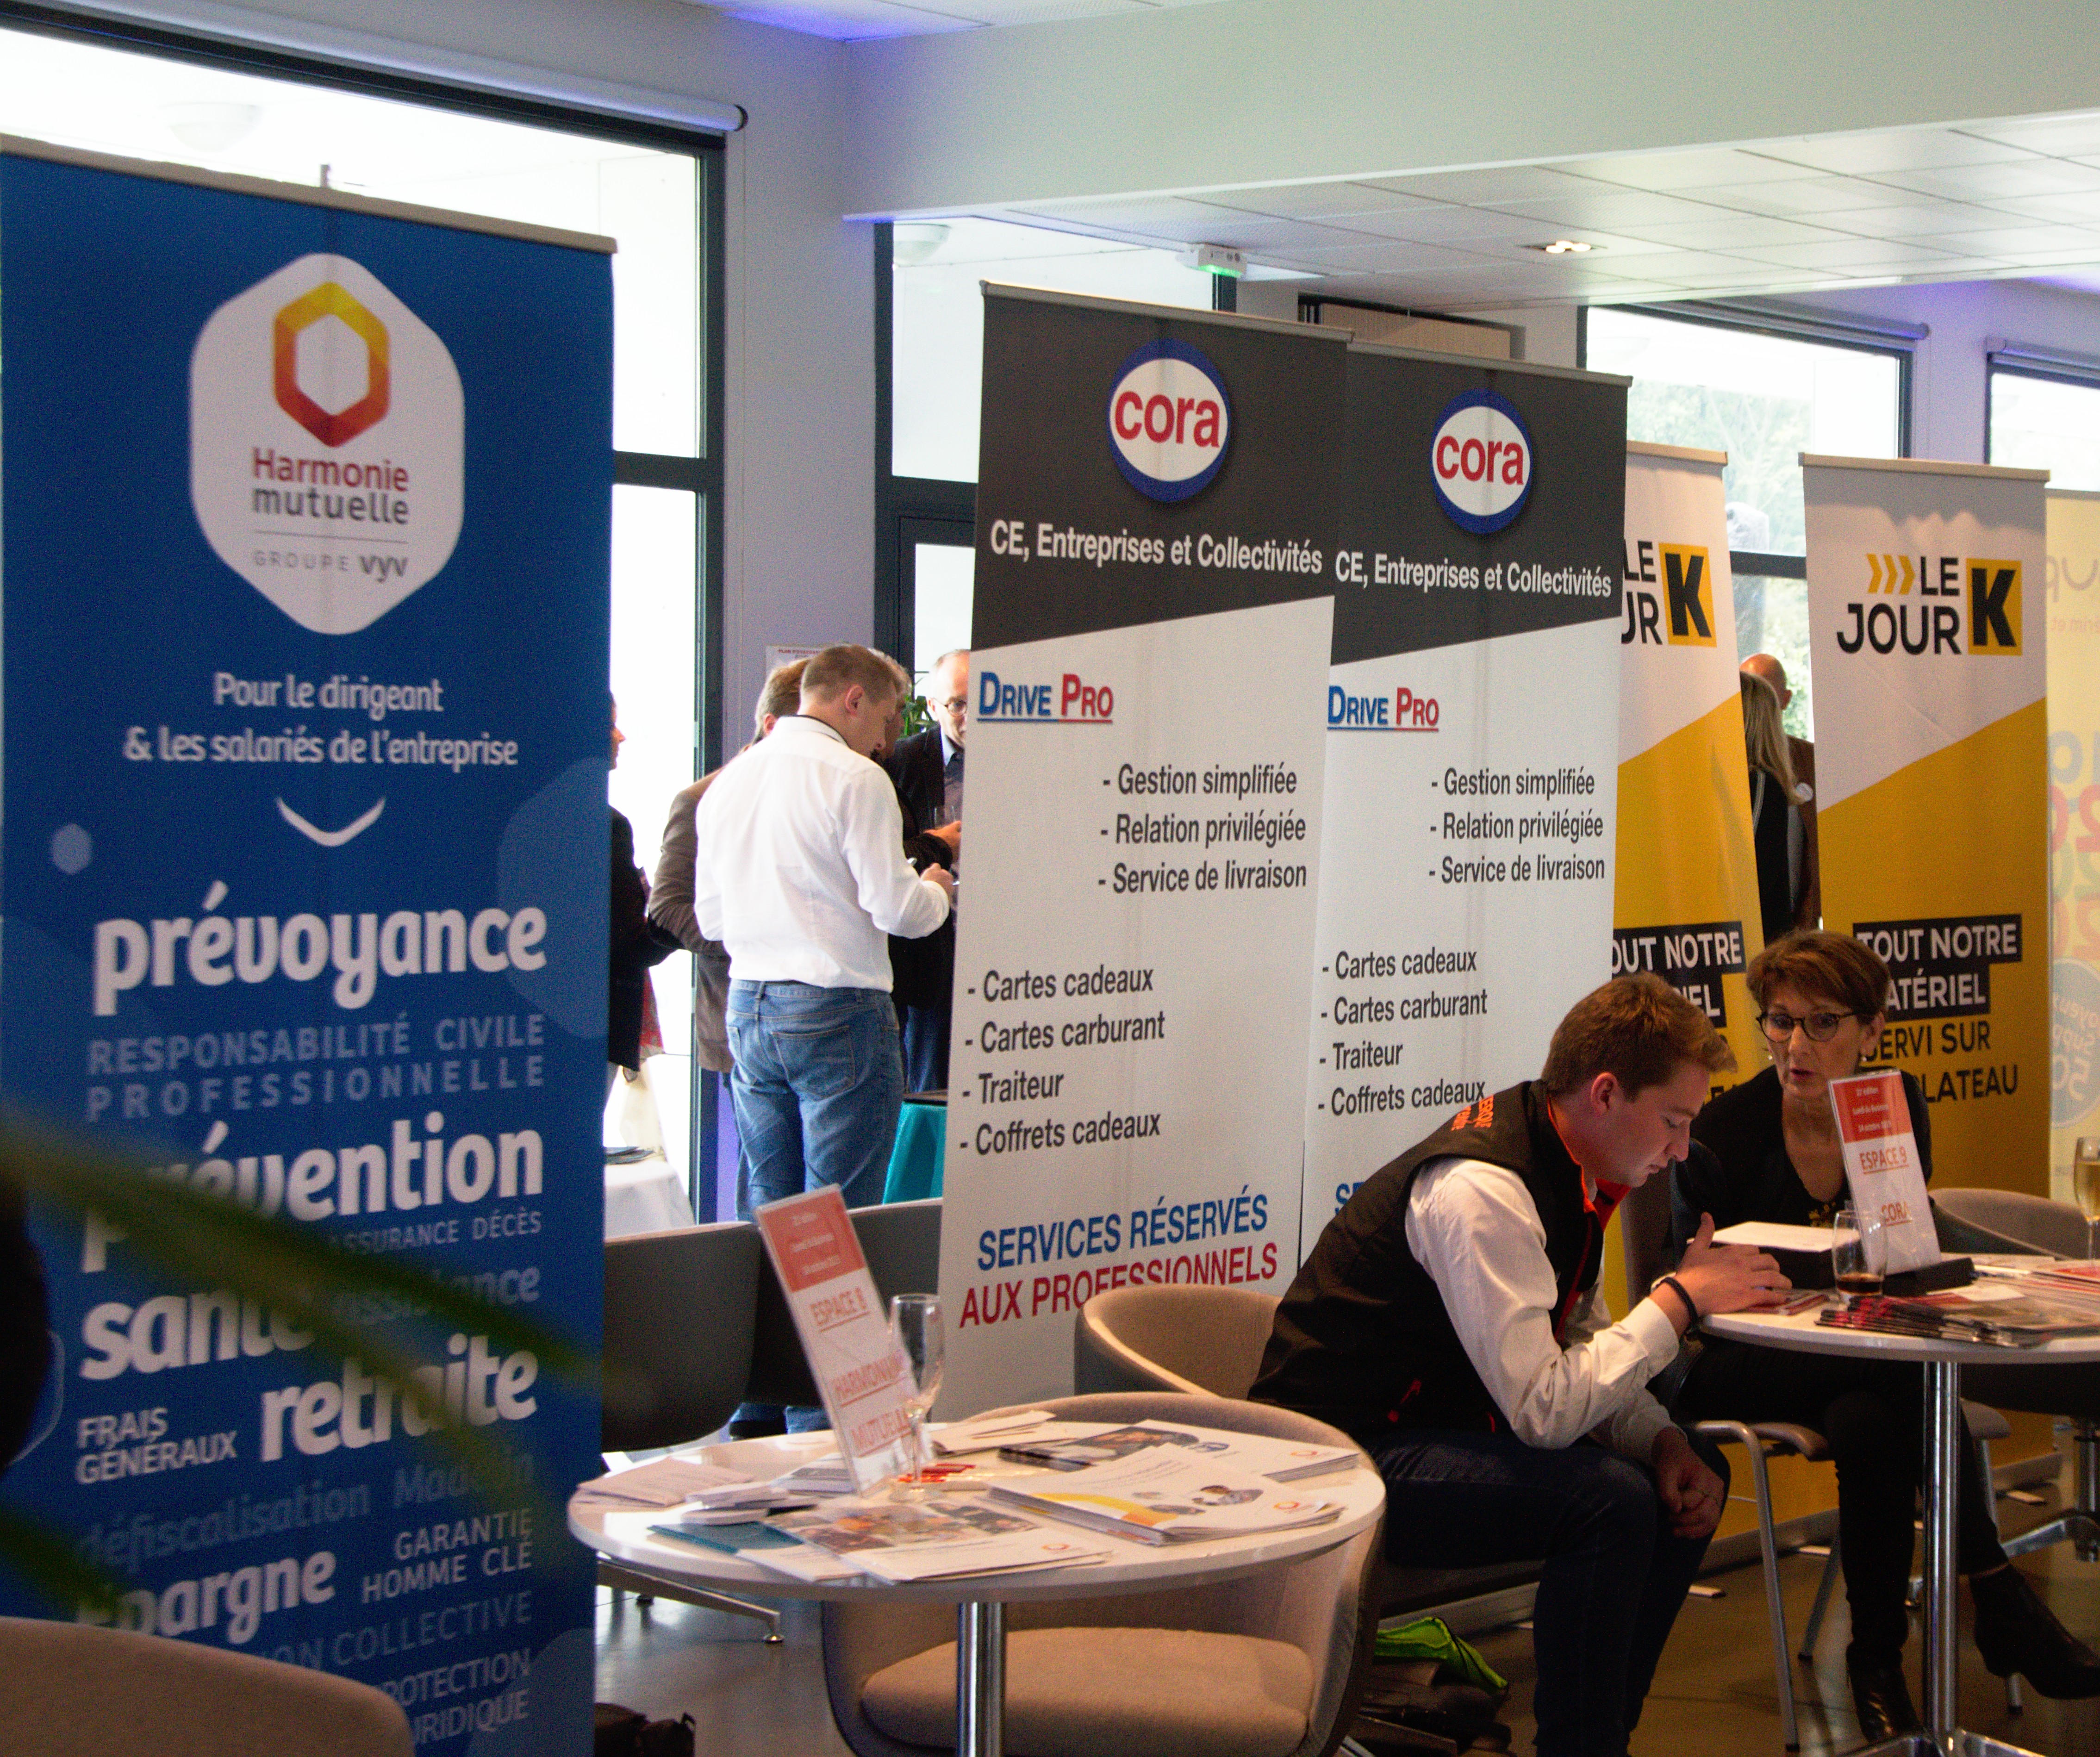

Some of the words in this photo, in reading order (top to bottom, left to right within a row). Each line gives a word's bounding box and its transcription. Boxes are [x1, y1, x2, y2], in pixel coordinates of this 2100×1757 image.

[1115, 391, 1221, 448] cora
[253, 447, 409, 492] Harmonie
[1436, 436, 1524, 485] cora
[253, 488, 409, 525] mutuelle
[255, 549, 349, 572] GROUPE
[359, 555, 409, 583] vyv
[991, 519, 1029, 561] CE,
[1038, 523, 1165, 567] Entreprises
[1171, 535, 1192, 565] et
[1197, 533, 1323, 574] Collectivités
[1335, 551, 1369, 589] CE,
[1375, 554, 1479, 593] Entreprises
[1484, 563, 1502, 591] et
[1507, 561, 1612, 598] Collectivités
[1665, 552, 1712, 638] K
[1920, 557, 1960, 596] LE
[1972, 568, 2017, 647] K
[1837, 603, 1963, 656] JOUR
[213, 671, 281, 706] Pour
[286, 674, 314, 708] le
[319, 674, 444, 721] dirigeant
[123, 725, 153, 761] &
[158, 725, 206, 762] les
[210, 725, 324, 763] salariés
[329, 730, 367, 764] de
[372, 730, 519, 774] l'entreprise
[1118, 764, 1197, 795] Gestion
[1203, 762, 1297, 800] simplifiée
[1444, 767, 1511, 796] Gestion
[1515, 766, 1595, 801] simplifiée
[1115, 813, 1200, 844] Relation
[1205, 810, 1307, 849] privilégiée
[1443, 812, 1514, 841] Relation
[1519, 809, 1604, 844] privilégiée
[1113, 861, 1190, 893] Service
[1195, 861, 1219, 891] de
[1225, 859, 1307, 890] livraison
[1441, 856, 1507, 885] Service
[1511, 855, 1532, 881] de
[1536, 854, 1605, 881] livraison
[94, 879, 548, 1016] prévoyance
[1612, 936, 1657, 974] OUT
[1664, 930, 1742, 970] NOTRE
[1931, 923, 2017, 959] NOTRE
[983, 969, 1057, 1002] Cartes
[1064, 964, 1154, 997] cadeaux
[1335, 950, 1396, 980] Cartes
[1402, 947, 1477, 975] cadeaux
[1334, 996, 1395, 1025] Cartes
[1399, 989, 1488, 1021] carburant
[1886, 968, 1986, 1011] ATÉRIEL
[89, 1011, 411, 1074] RESPONSABILITÉ
[435, 1014, 545, 1051] CIVILE
[980, 1020, 1054, 1053] Cartes
[1061, 1011, 1165, 1047] carburant
[1942, 1022, 1991, 1056] SUR
[1332, 1041, 1403, 1071] Traiteur
[86, 1055, 545, 1121] PROFESSIONNELLE
[978, 1070, 1065, 1105] Traiteur
[1331, 1084, 1405, 1116] Coffrets
[1411, 1078, 1486, 1109] cadeaux
[1922, 1065, 2019, 1103] LATEAU
[976, 1118, 1066, 1156] Coffrets
[1072, 1111, 1161, 1145] cadeaux
[1860, 1147, 1900, 1170] ESPACE
[1899, 1146, 1907, 1163] 9
[472, 1206, 543, 1241] DÉCÈS
[977, 1213, 1122, 1271] SERVICES
[1129, 1184, 1268, 1249] RÉSERVÉS
[809, 1289, 857, 1327] ESPACE
[959, 1279, 1022, 1330] AUX
[78, 1407, 168, 1449] FRAIS
[75, 1430, 238, 1484] GÉNÉRAUX
[393, 1508, 535, 1561] GARANTIE
[361, 1554, 467, 1604] HOMME
[482, 1533, 533, 1577] CLÉ
[331, 1590, 533, 1668] COLLECTIVE
[380, 1646, 531, 1707] ROTECTION
